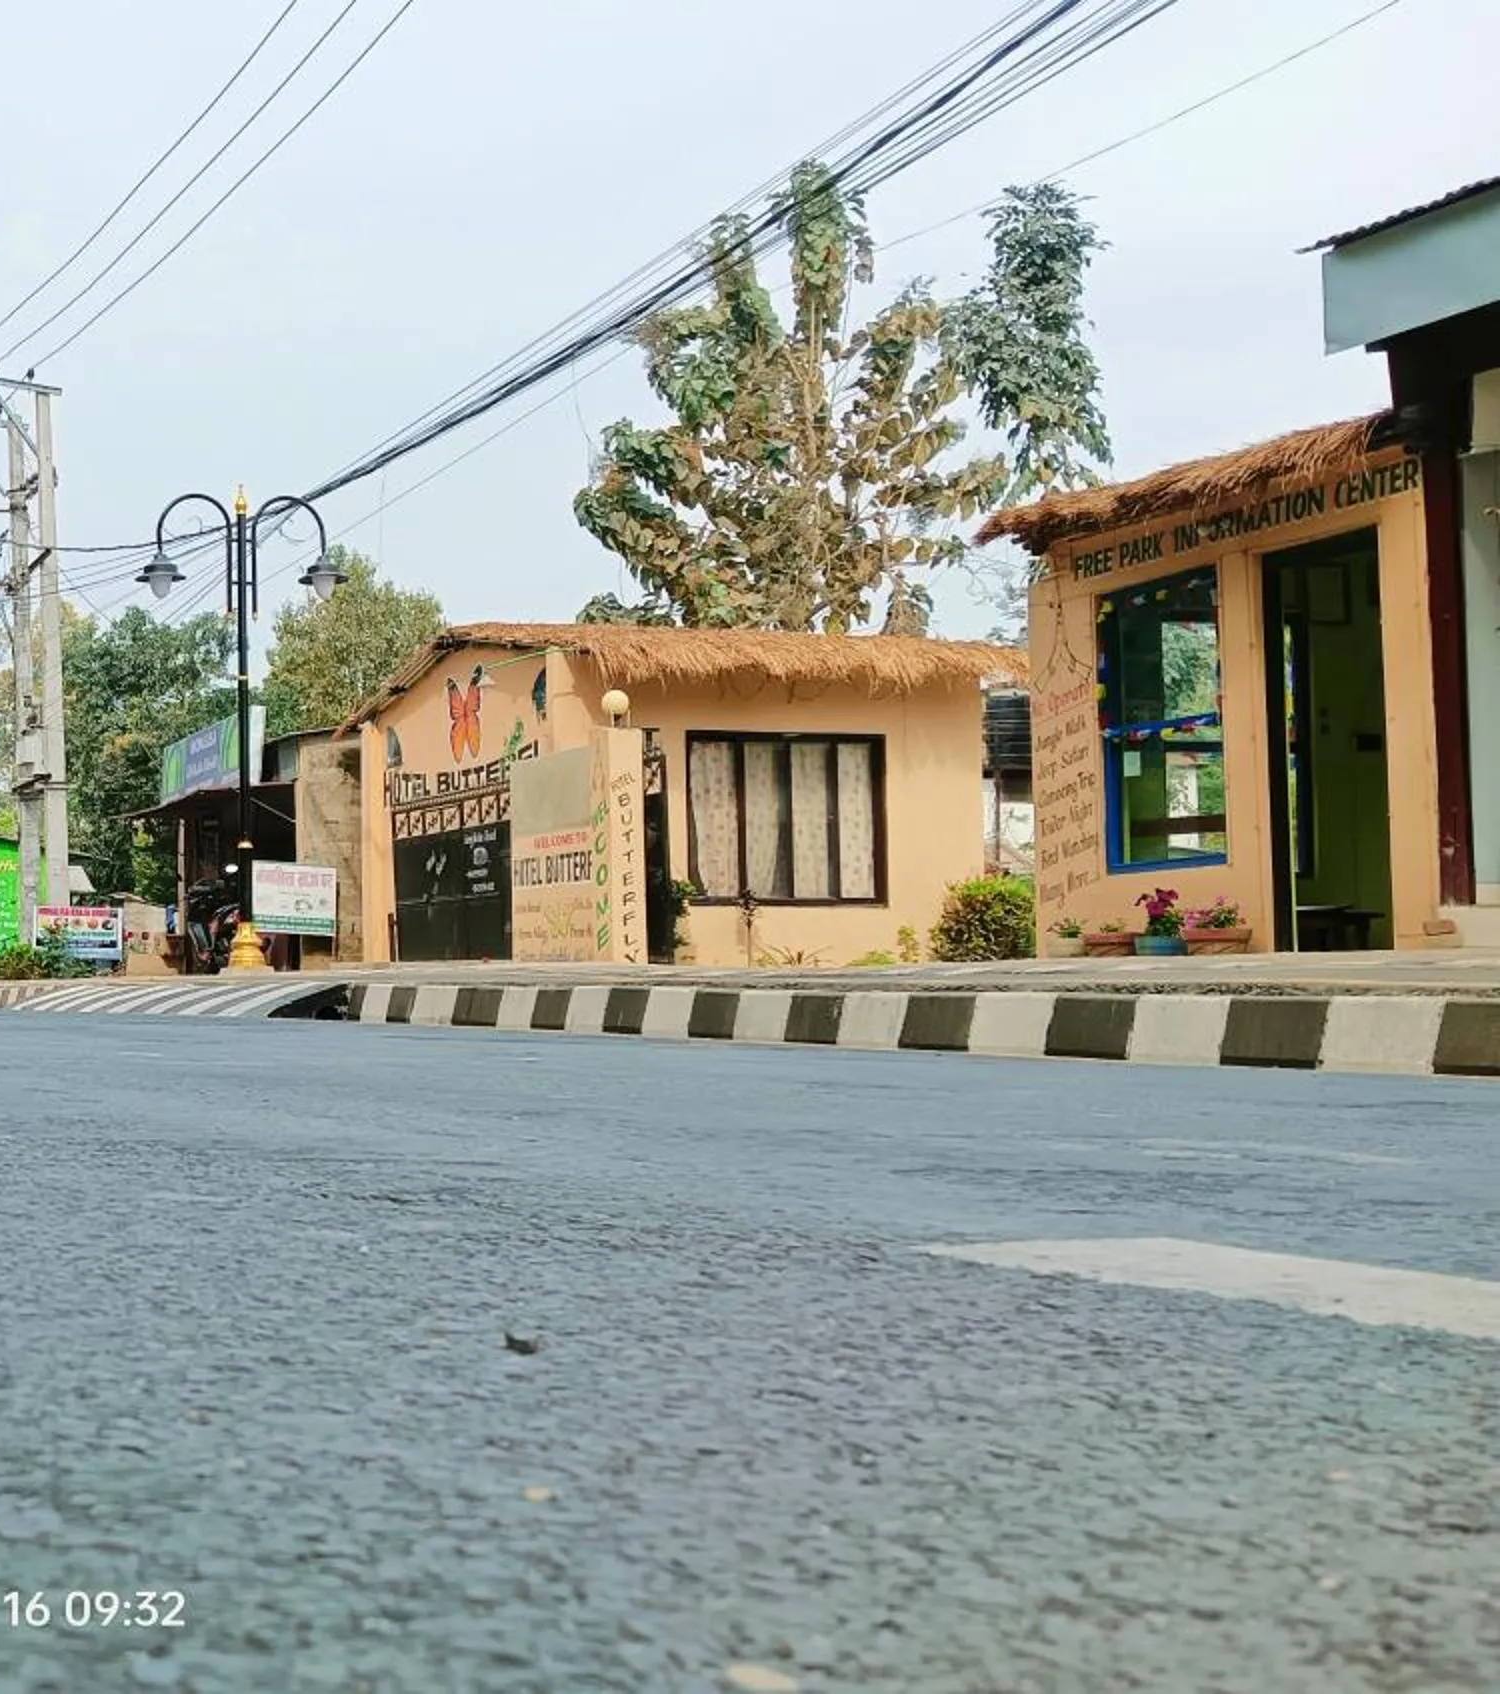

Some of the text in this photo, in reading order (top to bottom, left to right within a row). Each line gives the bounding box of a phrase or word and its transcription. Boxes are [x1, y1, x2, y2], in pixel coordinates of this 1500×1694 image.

[1074, 459, 1420, 582] FREE PARK INFORMATION CENTER
[383, 770, 431, 809] HOTEL
[611, 771, 636, 793] HOTEL
[513, 856, 542, 888] HOTEL
[617, 794, 641, 965] BUTTERFLY
